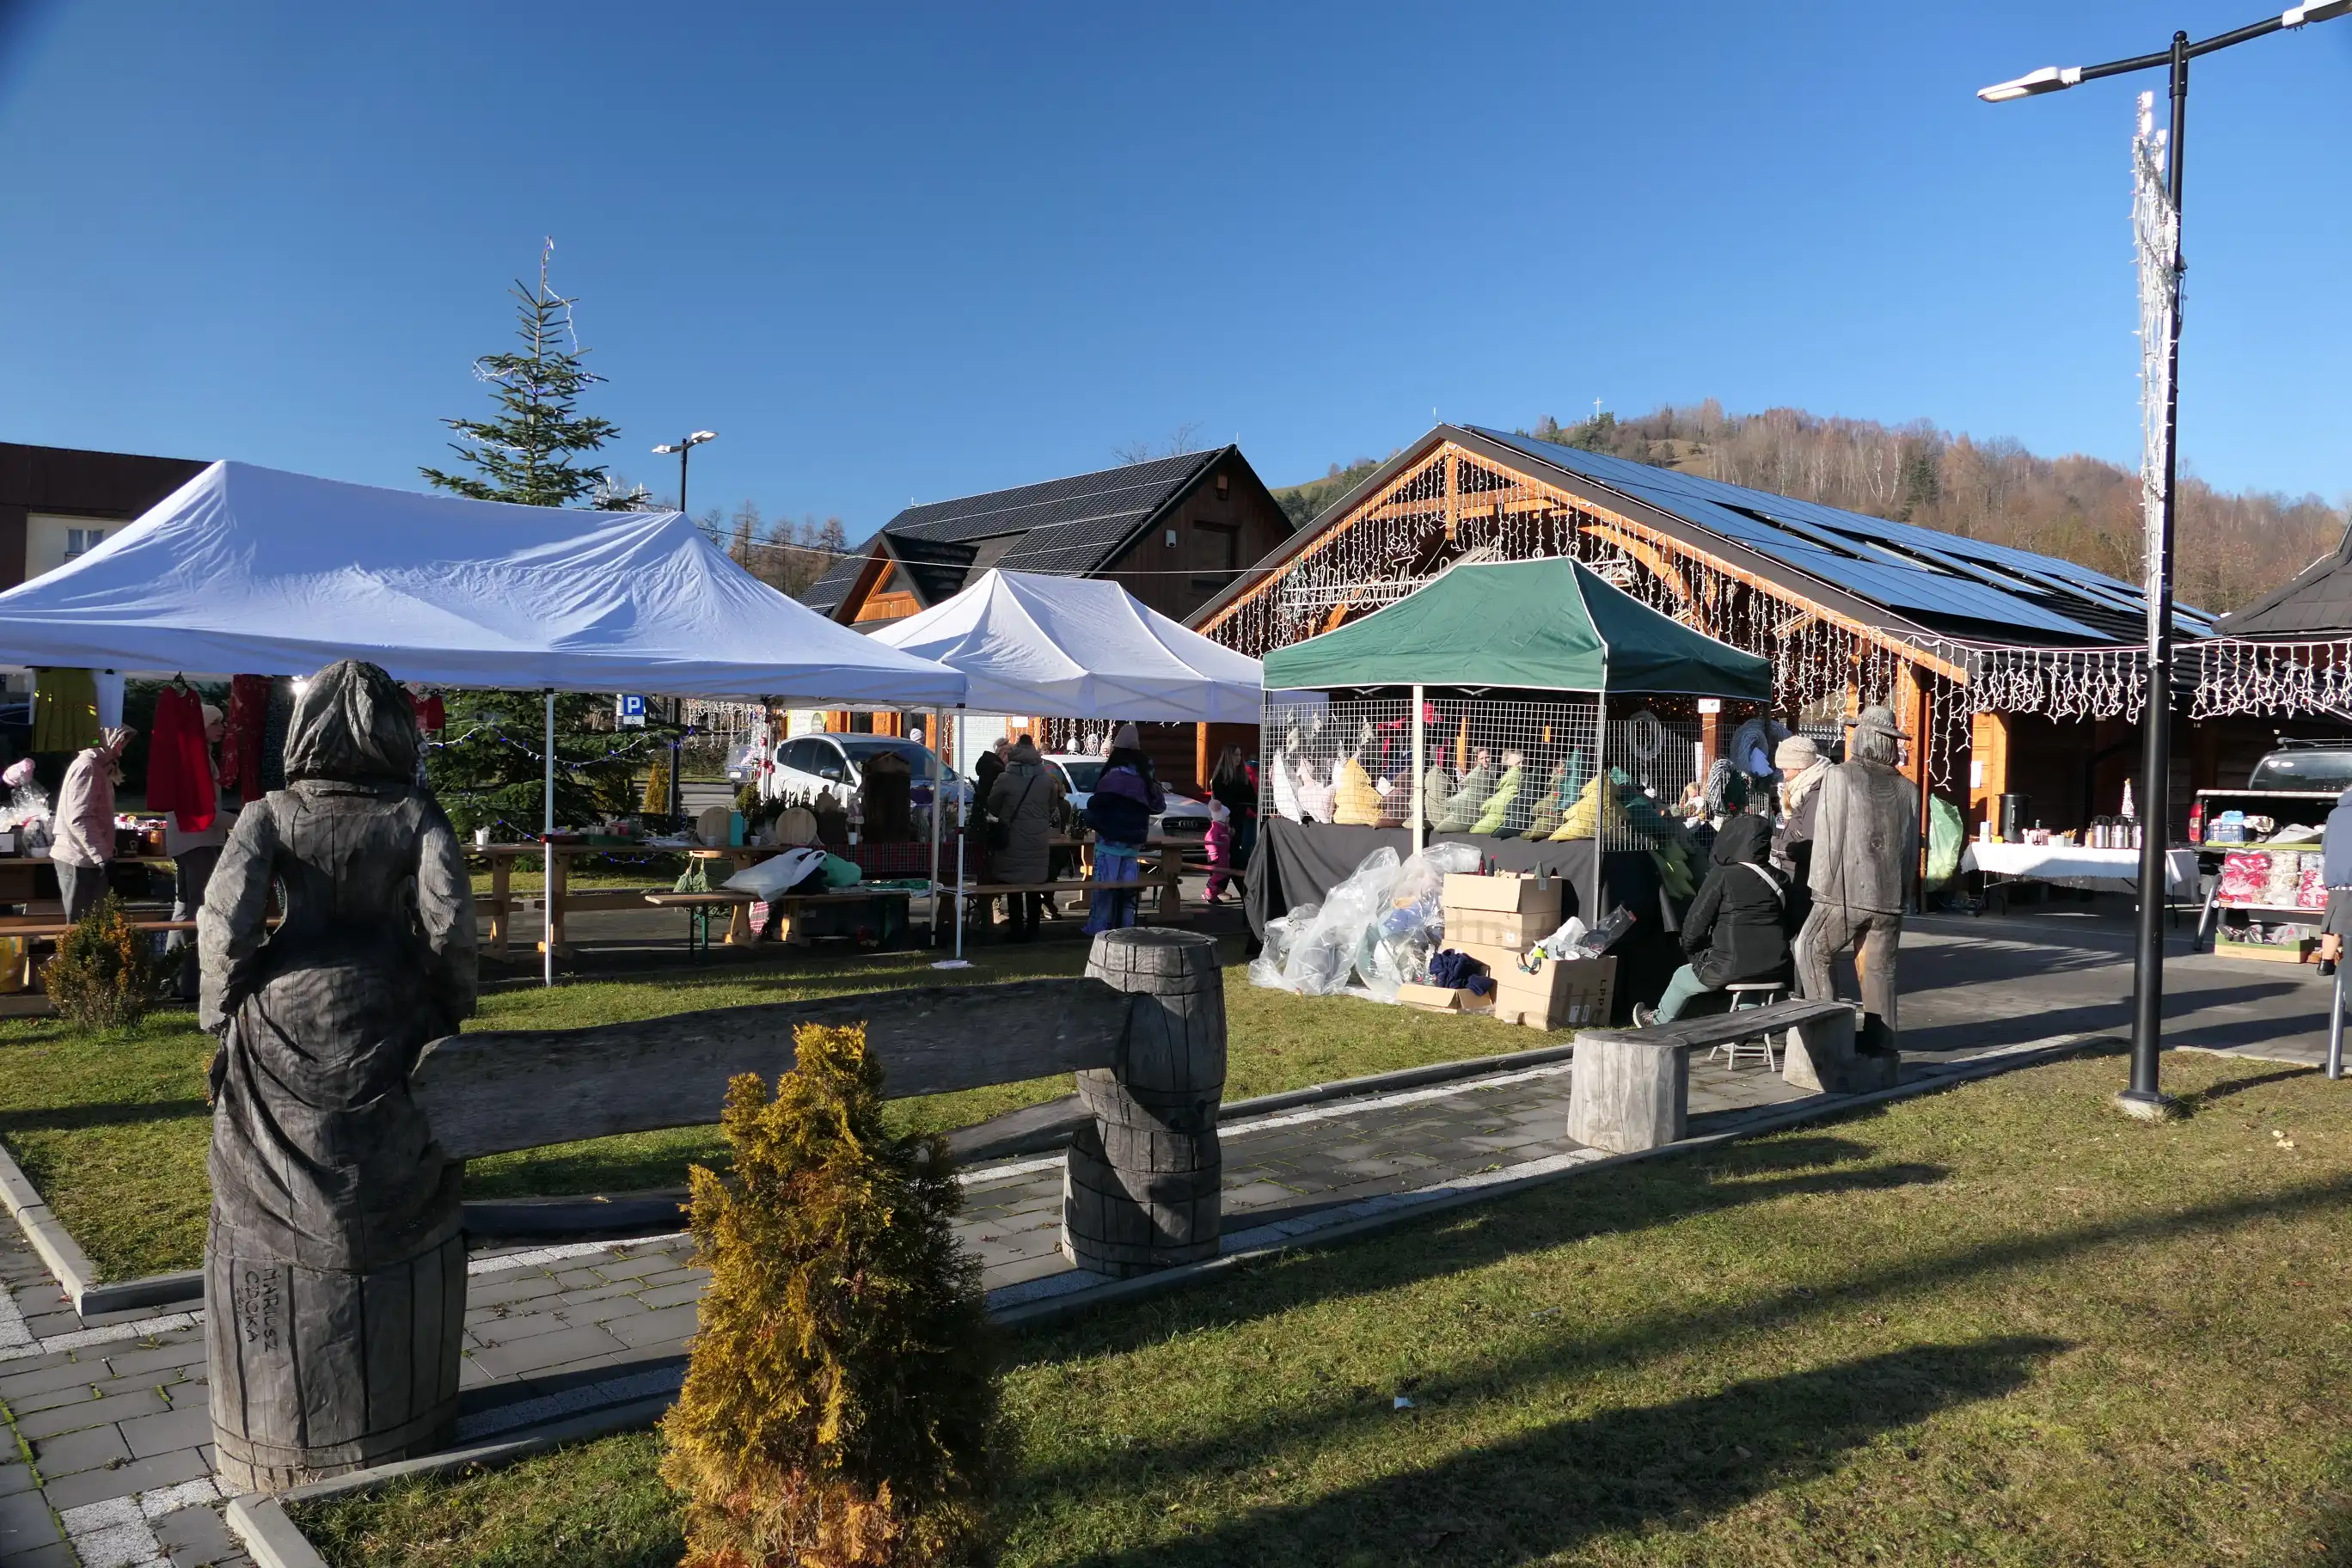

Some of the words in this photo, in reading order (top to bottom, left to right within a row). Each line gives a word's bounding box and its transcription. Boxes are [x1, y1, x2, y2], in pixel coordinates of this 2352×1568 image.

[628, 697, 640, 714] P
[1598, 979, 1607, 1006] LPP
[263, 1267, 279, 1352] MARIUSZ
